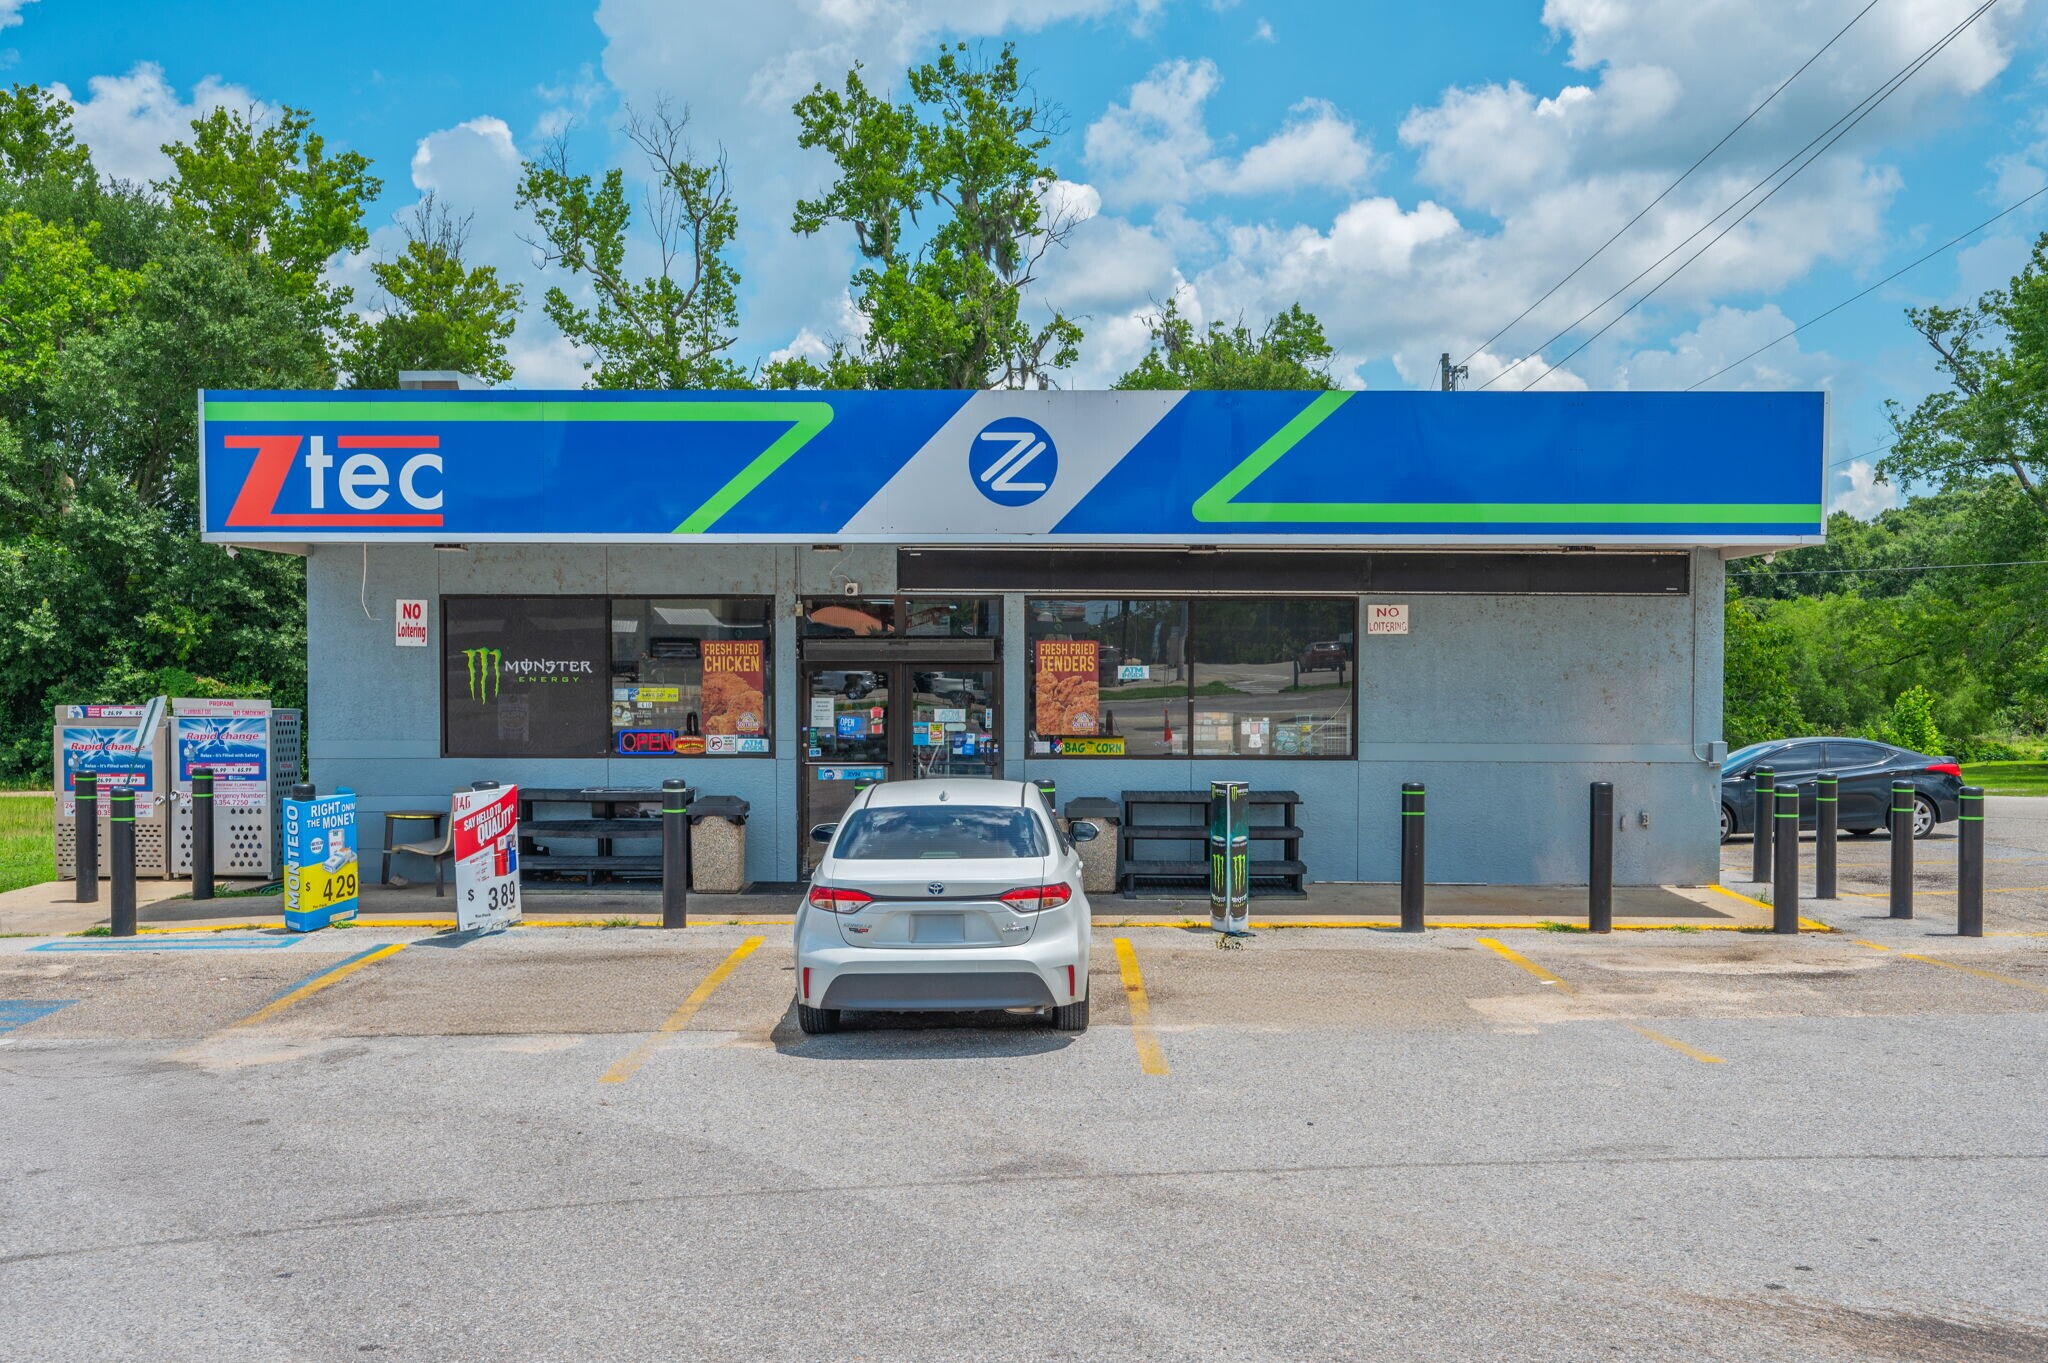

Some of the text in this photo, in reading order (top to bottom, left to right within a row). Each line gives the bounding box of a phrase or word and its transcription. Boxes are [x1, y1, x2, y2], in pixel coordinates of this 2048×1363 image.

[224, 435, 444, 527] Ztec
[402, 603, 422, 619] NO
[1376, 607, 1400, 618] NO
[397, 622, 426, 643] Loitering
[1369, 621, 1407, 632] LOITERING
[704, 643, 759, 655] FRESH FRIED
[1040, 643, 1095, 655] FRESH FRIED
[504, 658, 593, 674] MONSTER
[704, 655, 760, 673] CHICKEN
[1040, 655, 1095, 672] TENDERS
[840, 717, 855, 727] OPEN
[622, 733, 673, 751] OPEN
[743, 739, 763, 747] ATM
[1065, 743, 1122, 753] BAG CORN
[310, 801, 341, 818] RIGHT
[463, 802, 502, 832] SAY HELLO TO
[306, 812, 355, 830] THE MONEY
[286, 805, 300, 910] MONTEGO
[305, 873, 356, 902] $ 4.29
[467, 880, 515, 911] $ 3.89
